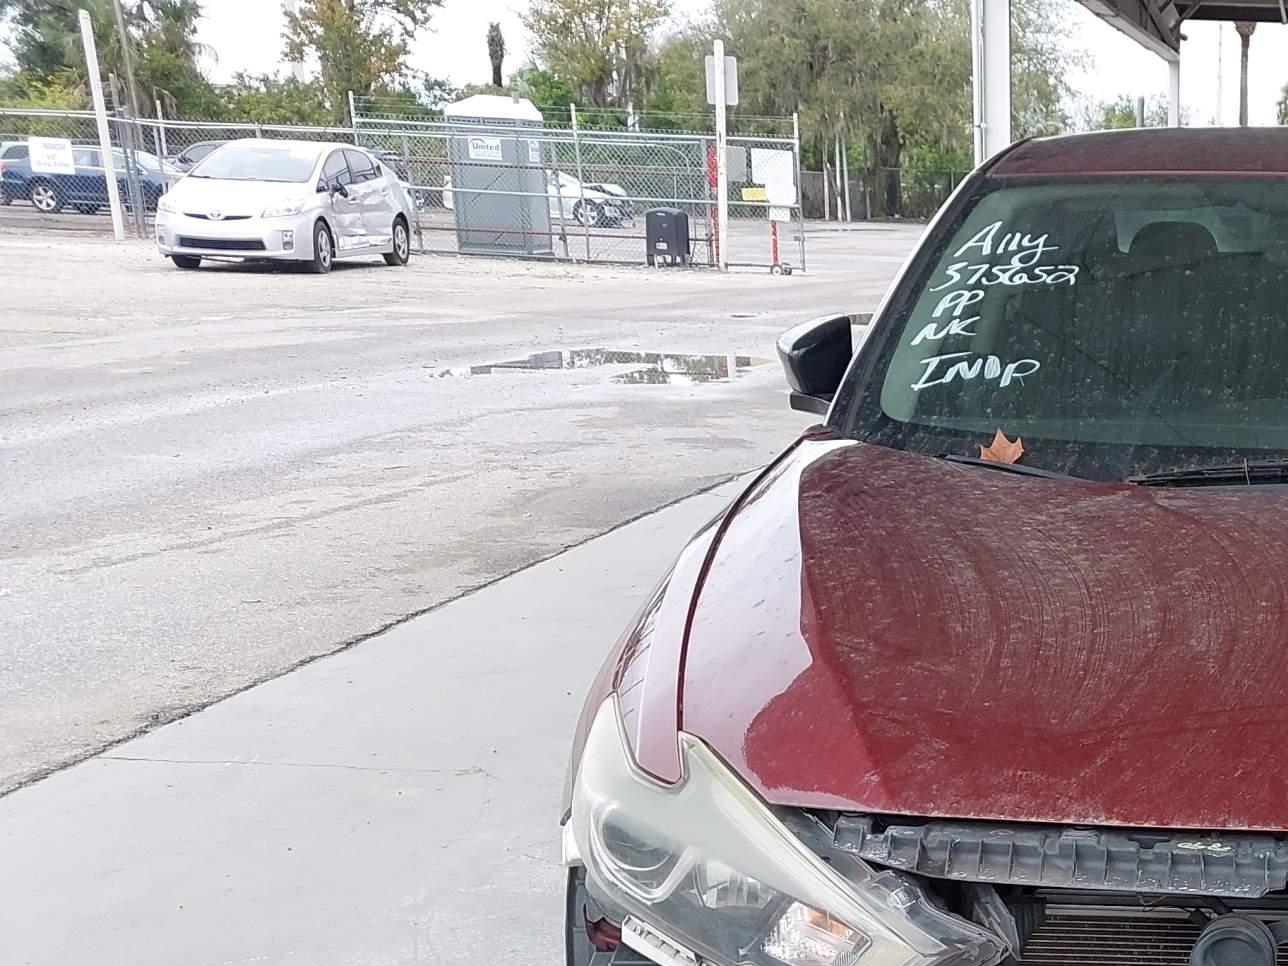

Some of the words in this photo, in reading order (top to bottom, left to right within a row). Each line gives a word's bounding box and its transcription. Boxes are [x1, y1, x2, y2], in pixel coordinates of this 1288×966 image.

[472, 142, 500, 151] United
[932, 289, 985, 318] PP
[910, 316, 981, 346] NK
